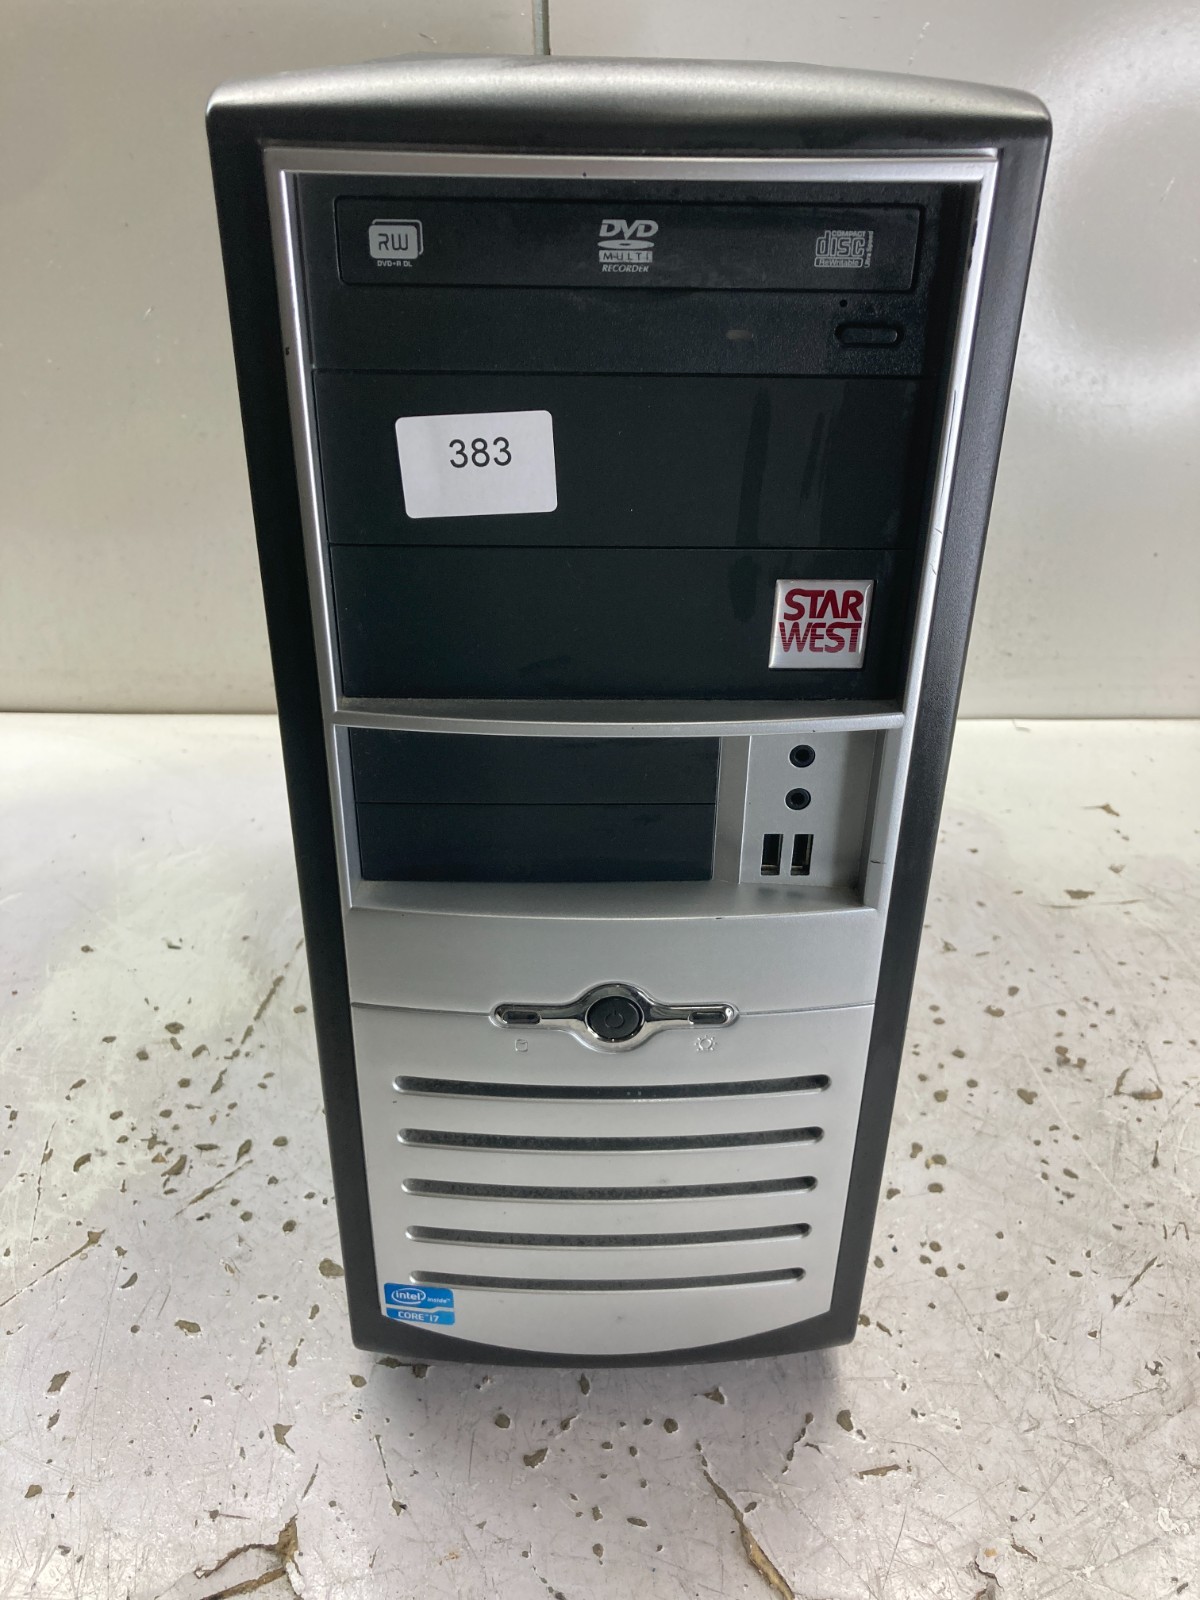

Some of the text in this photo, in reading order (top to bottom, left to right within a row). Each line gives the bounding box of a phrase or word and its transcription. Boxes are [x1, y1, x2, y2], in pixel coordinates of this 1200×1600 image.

[599, 219, 659, 240] DVD
[378, 233, 409, 251] RW
[816, 230, 866, 257] disc
[403, 260, 413, 268] DL
[603, 252, 650, 261] MULTI
[601, 264, 650, 273] RECORDER
[449, 436, 512, 468] 383
[783, 588, 864, 622] STAR
[779, 621, 862, 653] WEST
[395, 1290, 421, 1301] intel
[429, 1314, 440, 1323] i7
